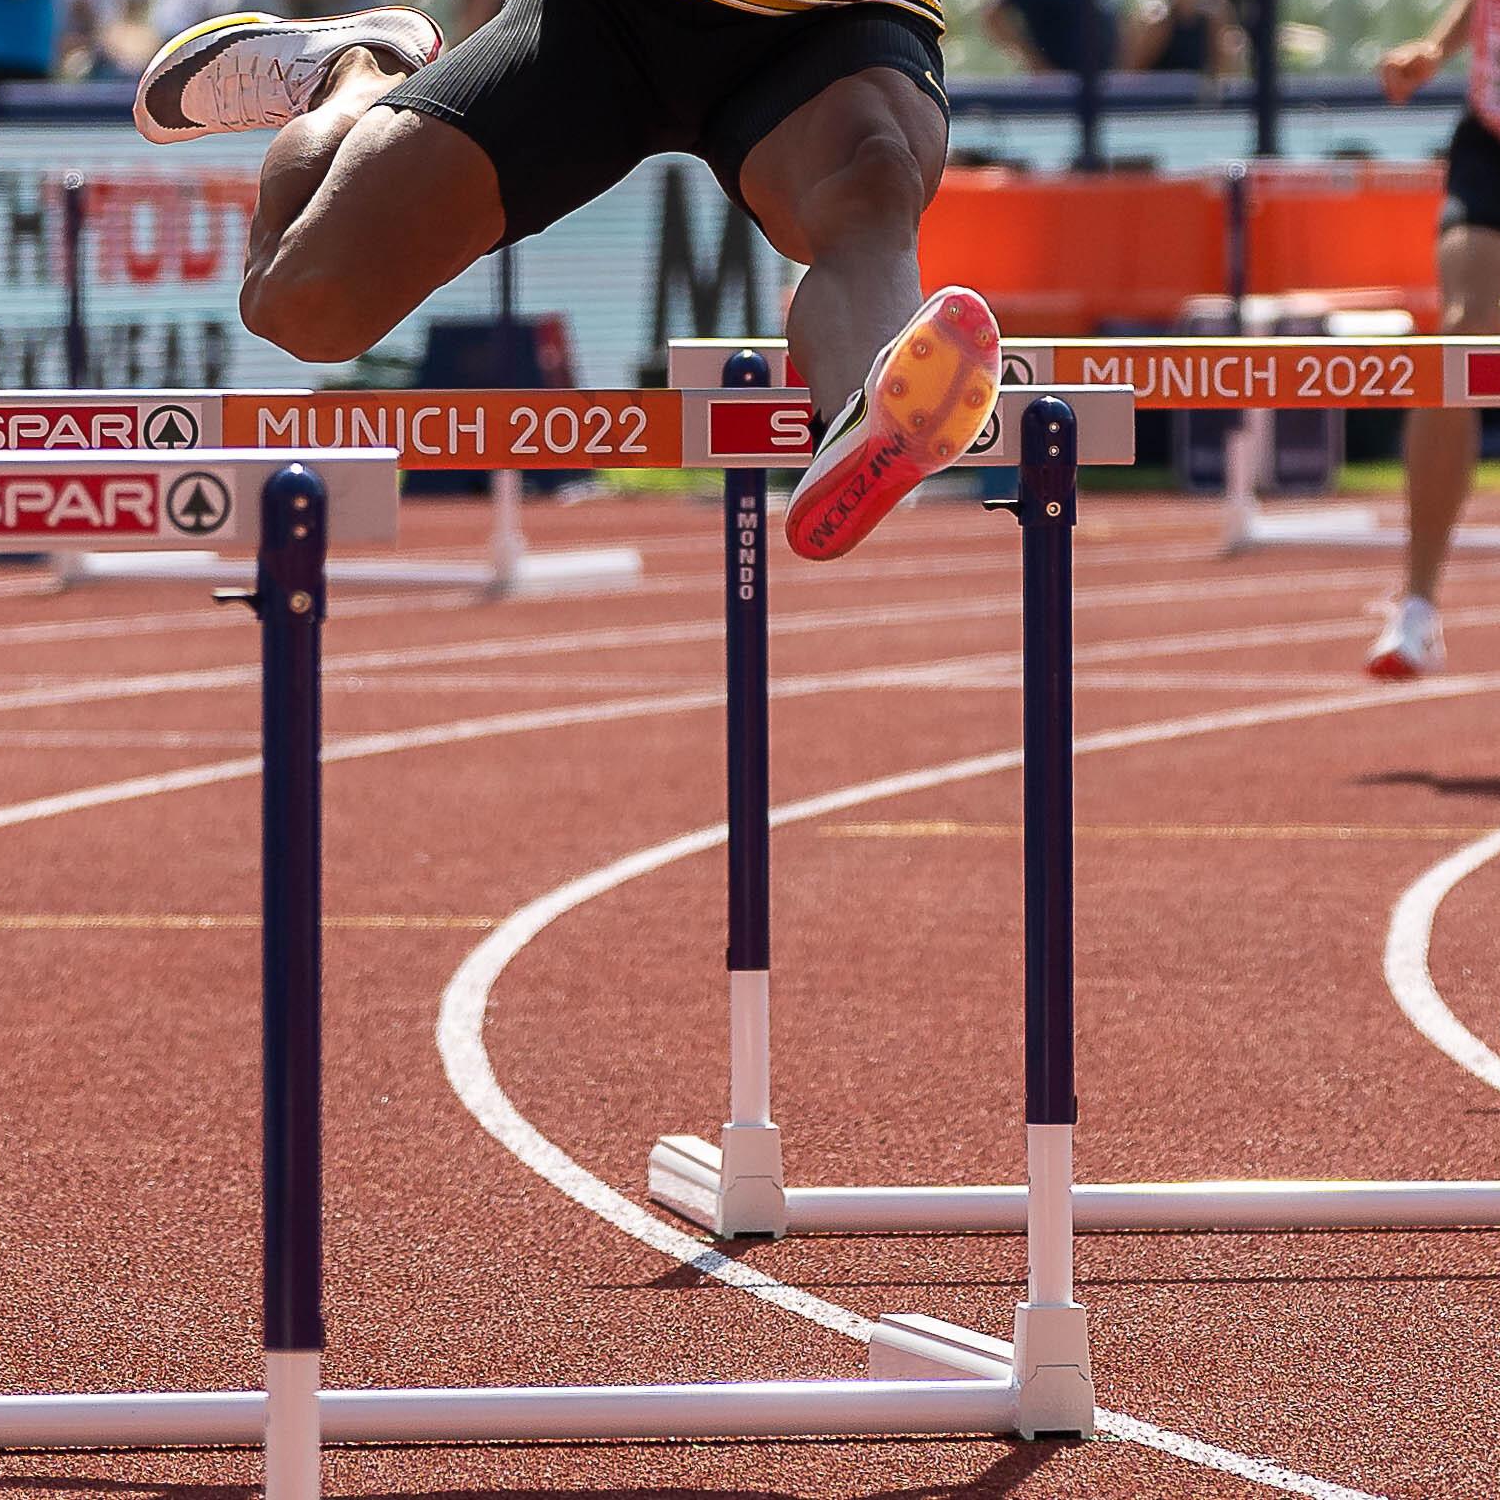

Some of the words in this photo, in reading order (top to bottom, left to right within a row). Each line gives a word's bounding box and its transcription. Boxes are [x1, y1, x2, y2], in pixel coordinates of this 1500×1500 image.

[1083, 357, 1279, 400] MUNICH
[1296, 356, 1416, 399] 2022
[256, 406, 487, 456] MUNICH
[509, 406, 648, 454] 2022
[736, 512, 760, 601] MONDO
